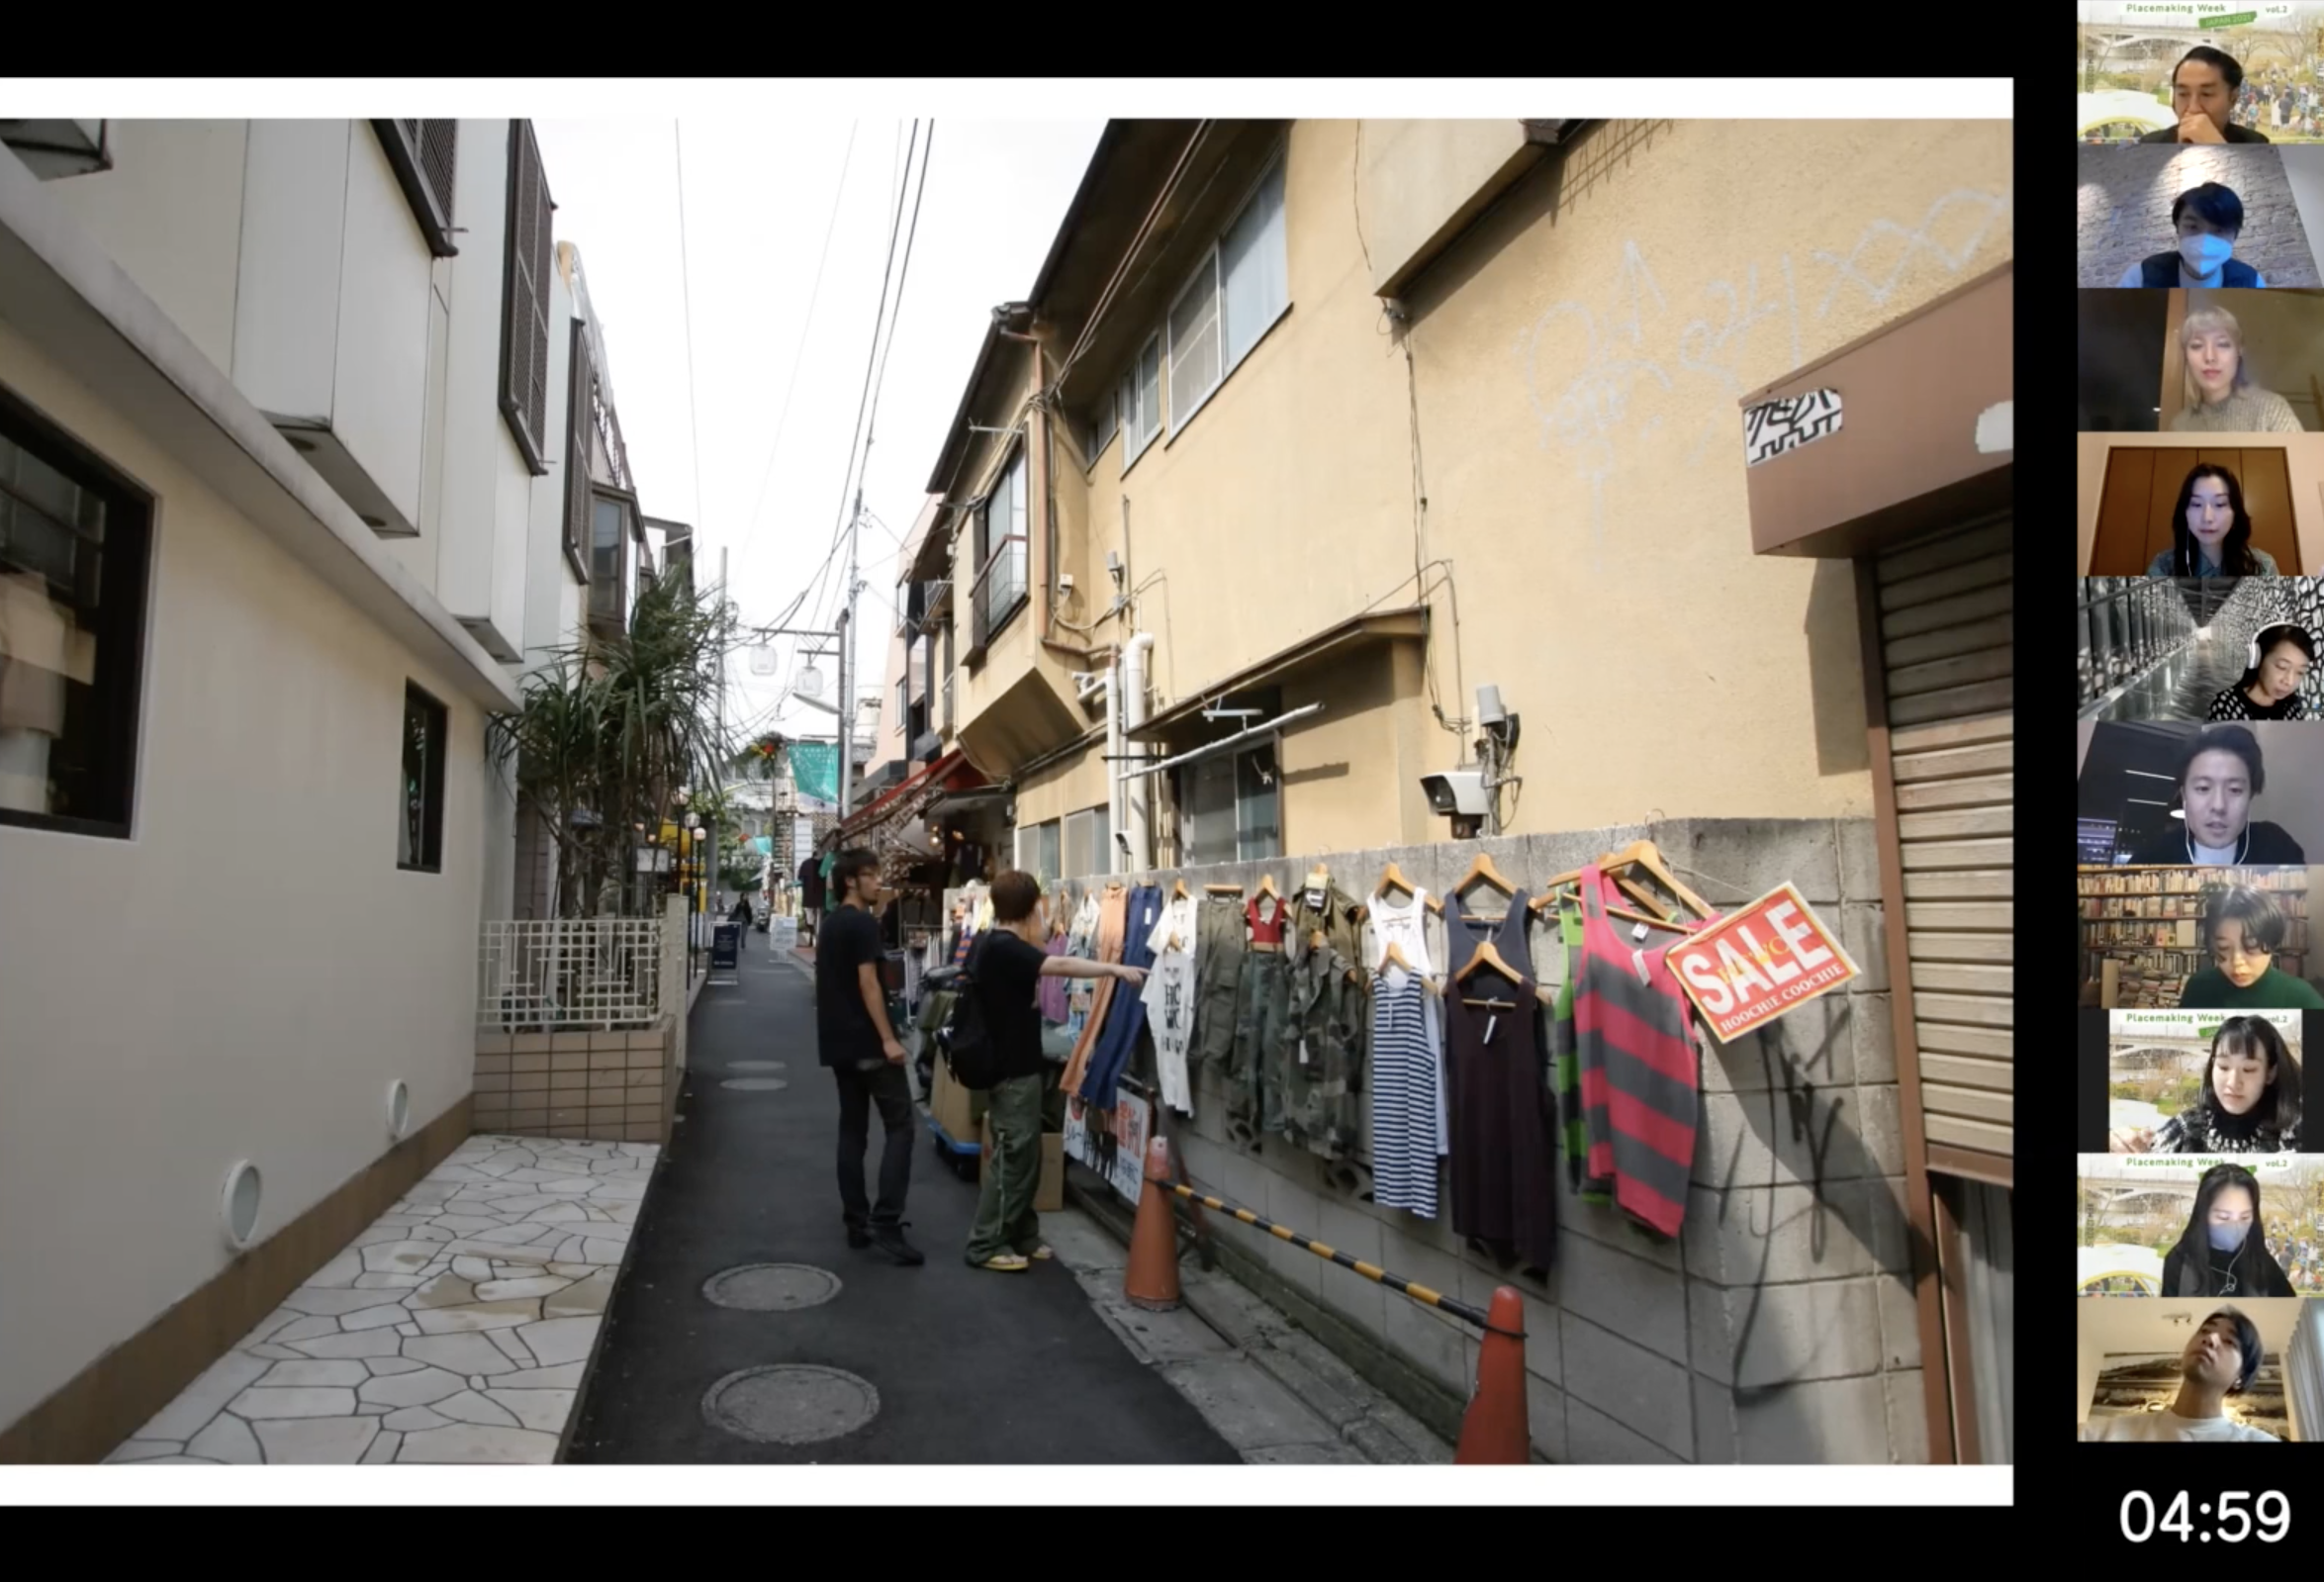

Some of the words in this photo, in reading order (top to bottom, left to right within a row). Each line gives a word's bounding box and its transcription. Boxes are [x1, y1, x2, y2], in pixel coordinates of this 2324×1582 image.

[1681, 899, 1833, 1014] SALE
[1720, 995, 1782, 1034] HOOCHIE
[1782, 963, 1845, 1001] COOCHIE
